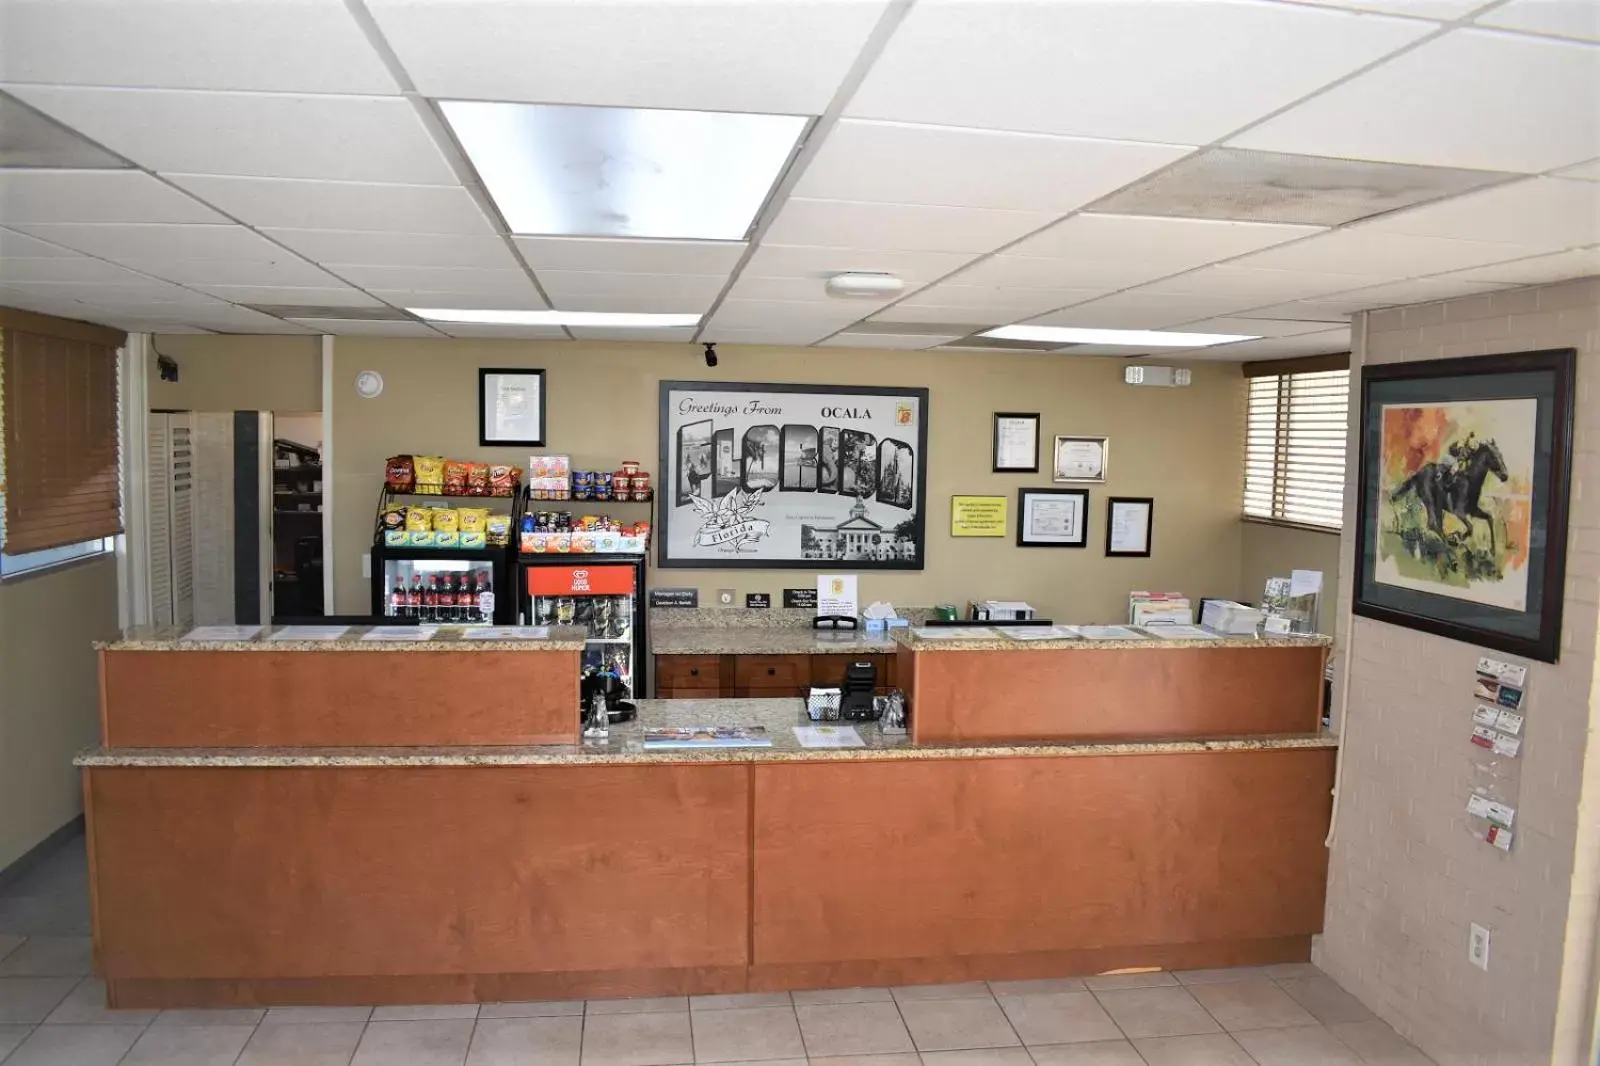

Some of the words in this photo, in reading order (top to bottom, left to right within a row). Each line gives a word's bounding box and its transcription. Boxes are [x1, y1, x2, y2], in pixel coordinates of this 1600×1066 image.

[678, 398, 738, 419] Greetings
[743, 400, 783, 415] From
[821, 407, 872, 419] OCALA
[711, 524, 753, 543] Florida
